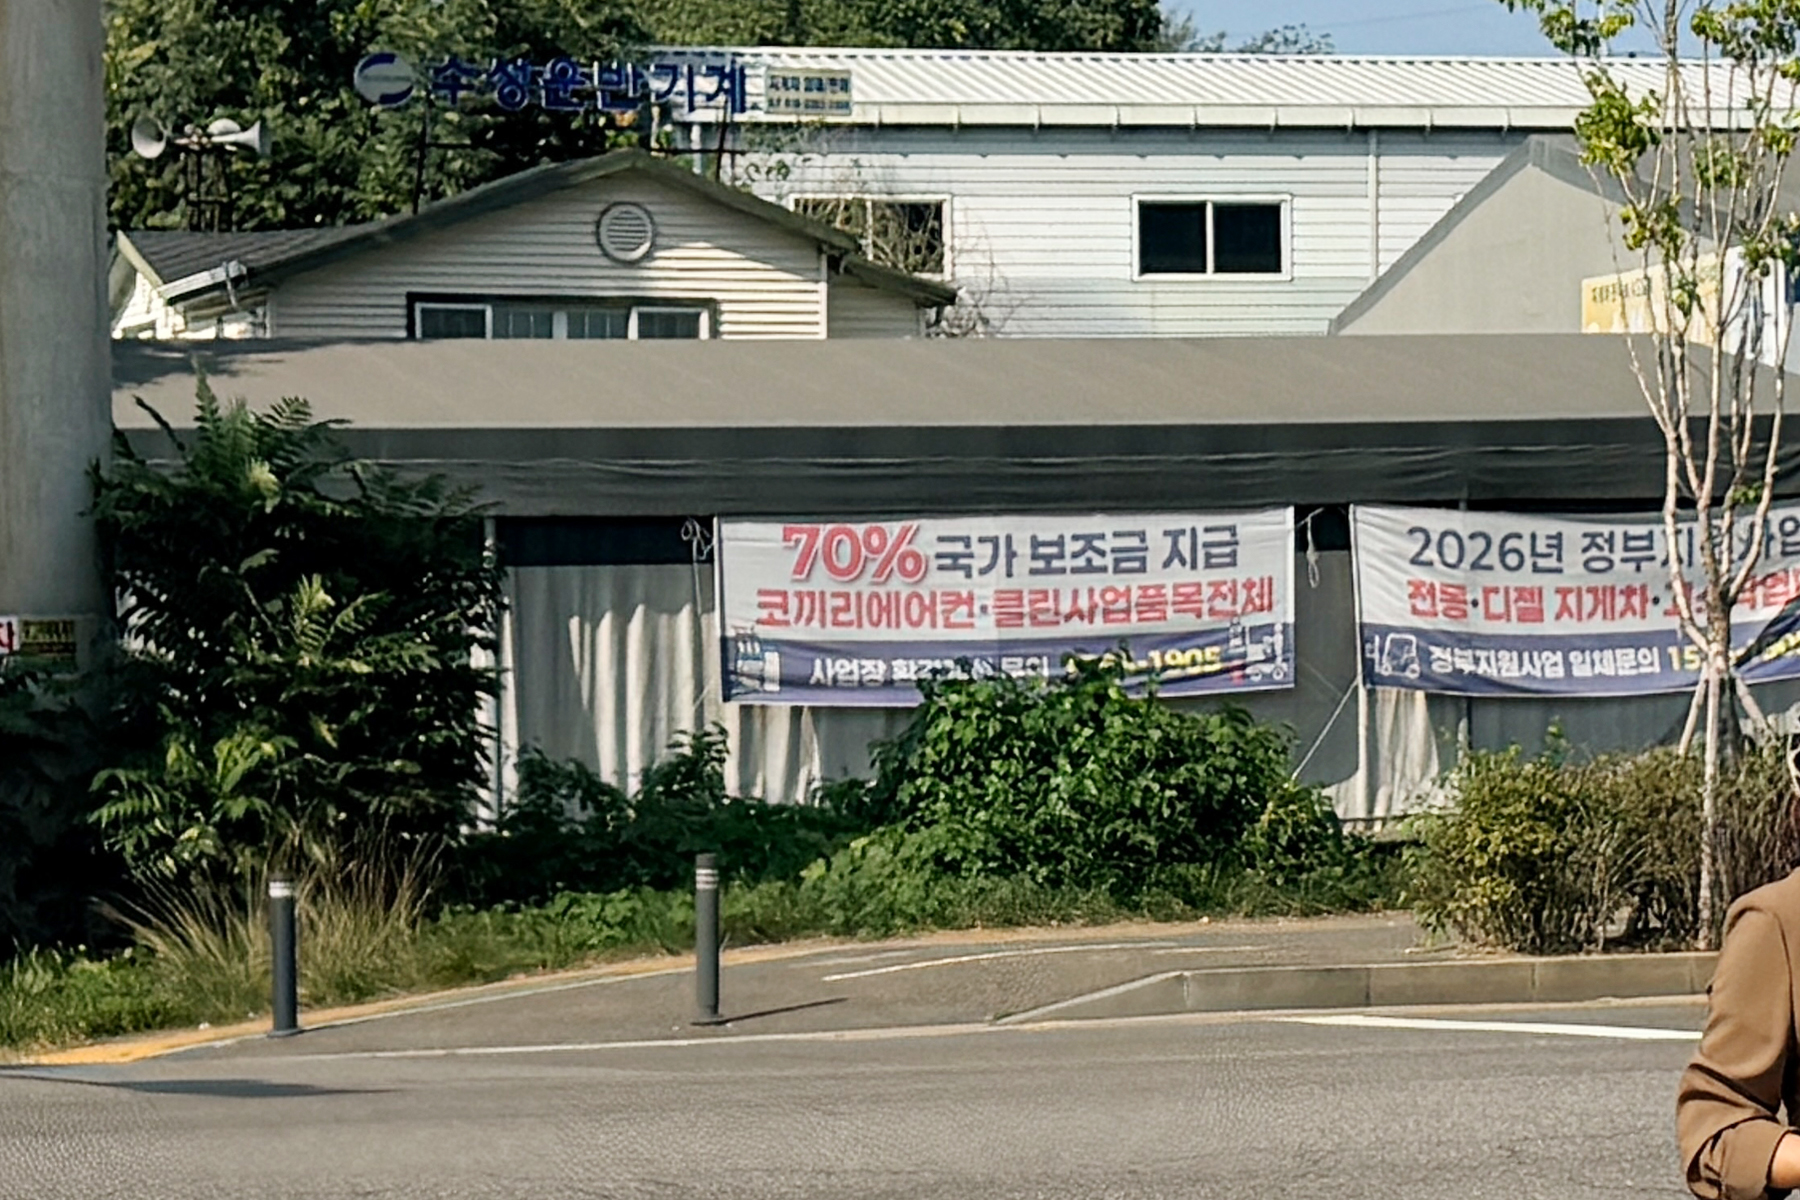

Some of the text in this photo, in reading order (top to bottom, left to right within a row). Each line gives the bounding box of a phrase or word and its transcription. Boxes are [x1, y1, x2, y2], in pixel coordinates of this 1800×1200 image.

[431, 56, 747, 114] 수성운반기계
[781, 523, 1240, 583] 70% 국가 보조금 지급
[1407, 526, 1564, 574] 2026년
[810, 657, 887, 686] 사업장
[1428, 645, 1565, 679] 정부지원사업
